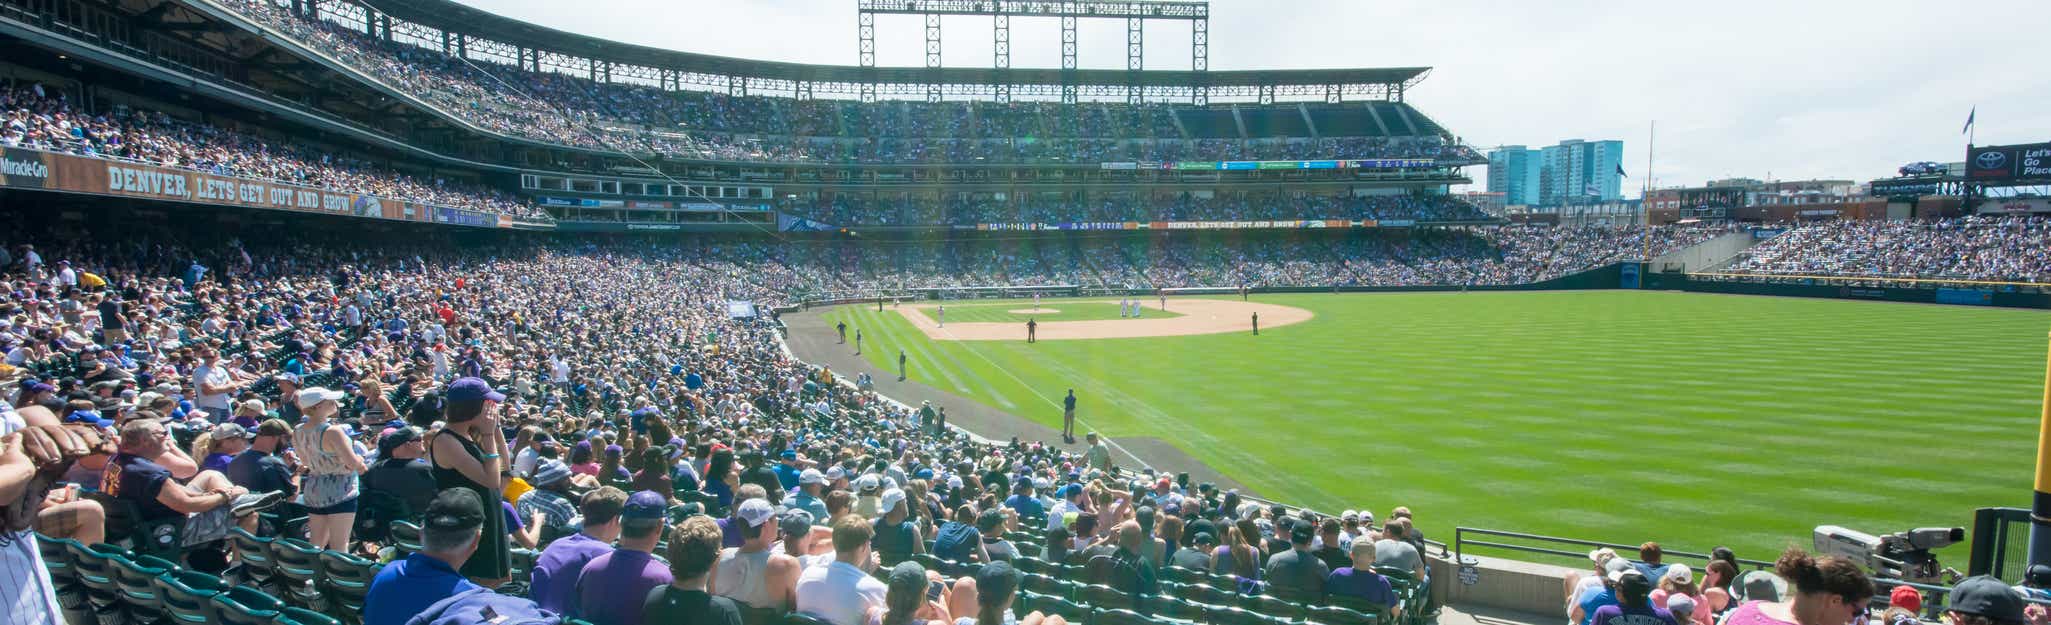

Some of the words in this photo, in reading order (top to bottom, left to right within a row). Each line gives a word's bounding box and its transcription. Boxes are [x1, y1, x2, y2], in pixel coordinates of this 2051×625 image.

[2024, 157, 2040, 166] Go
[108, 166, 192, 199] DENVER,
[197, 177, 235, 201] LETS
[239, 183, 265, 203] GET
[270, 187, 293, 206] OUT
[297, 191, 319, 209] AND
[323, 195, 350, 211] GROW
